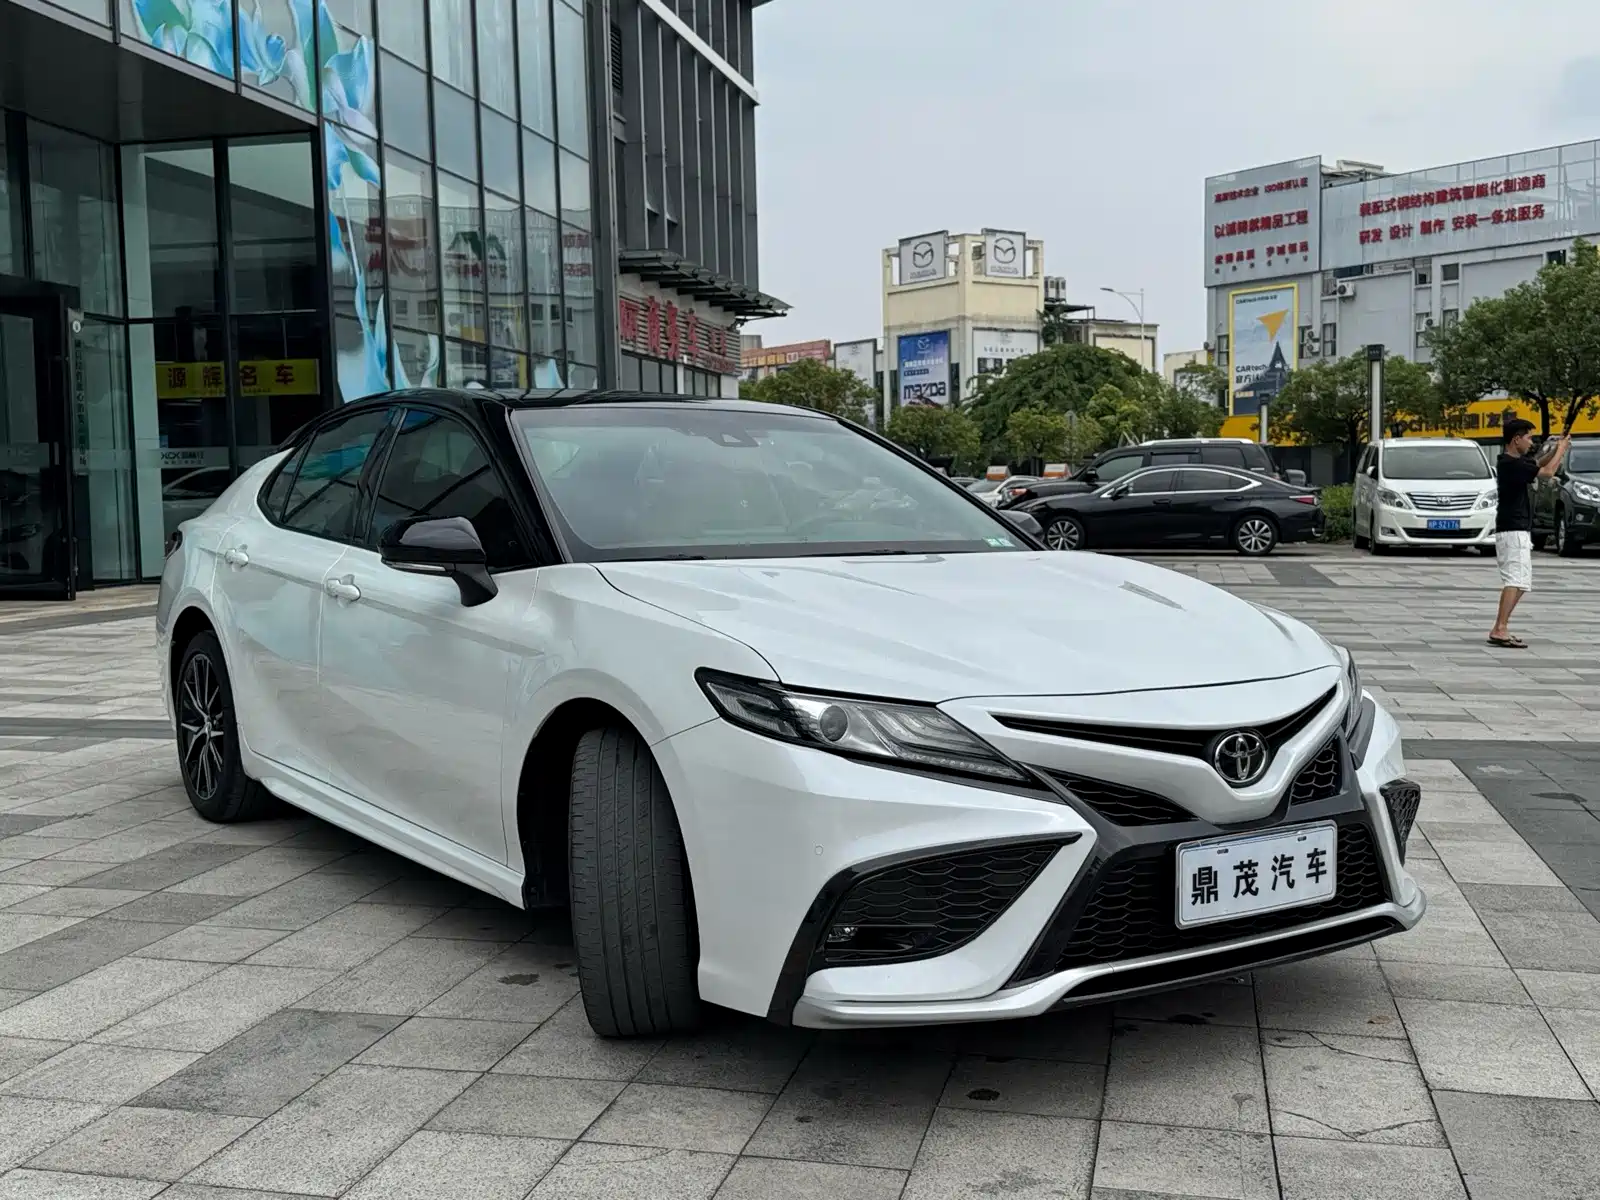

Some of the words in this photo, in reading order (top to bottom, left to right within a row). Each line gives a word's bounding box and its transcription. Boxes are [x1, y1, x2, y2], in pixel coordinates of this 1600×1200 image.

[1359, 173, 1547, 217] 装配式钢结构建筑智能化制造商
[1359, 228, 1383, 245] 研发
[1389, 223, 1414, 240] 设计
[1420, 218, 1446, 235] 制作
[1452, 204, 1546, 231] 安装一条龙服务
[1191, 847, 1328, 906] 鼎茂汽车
